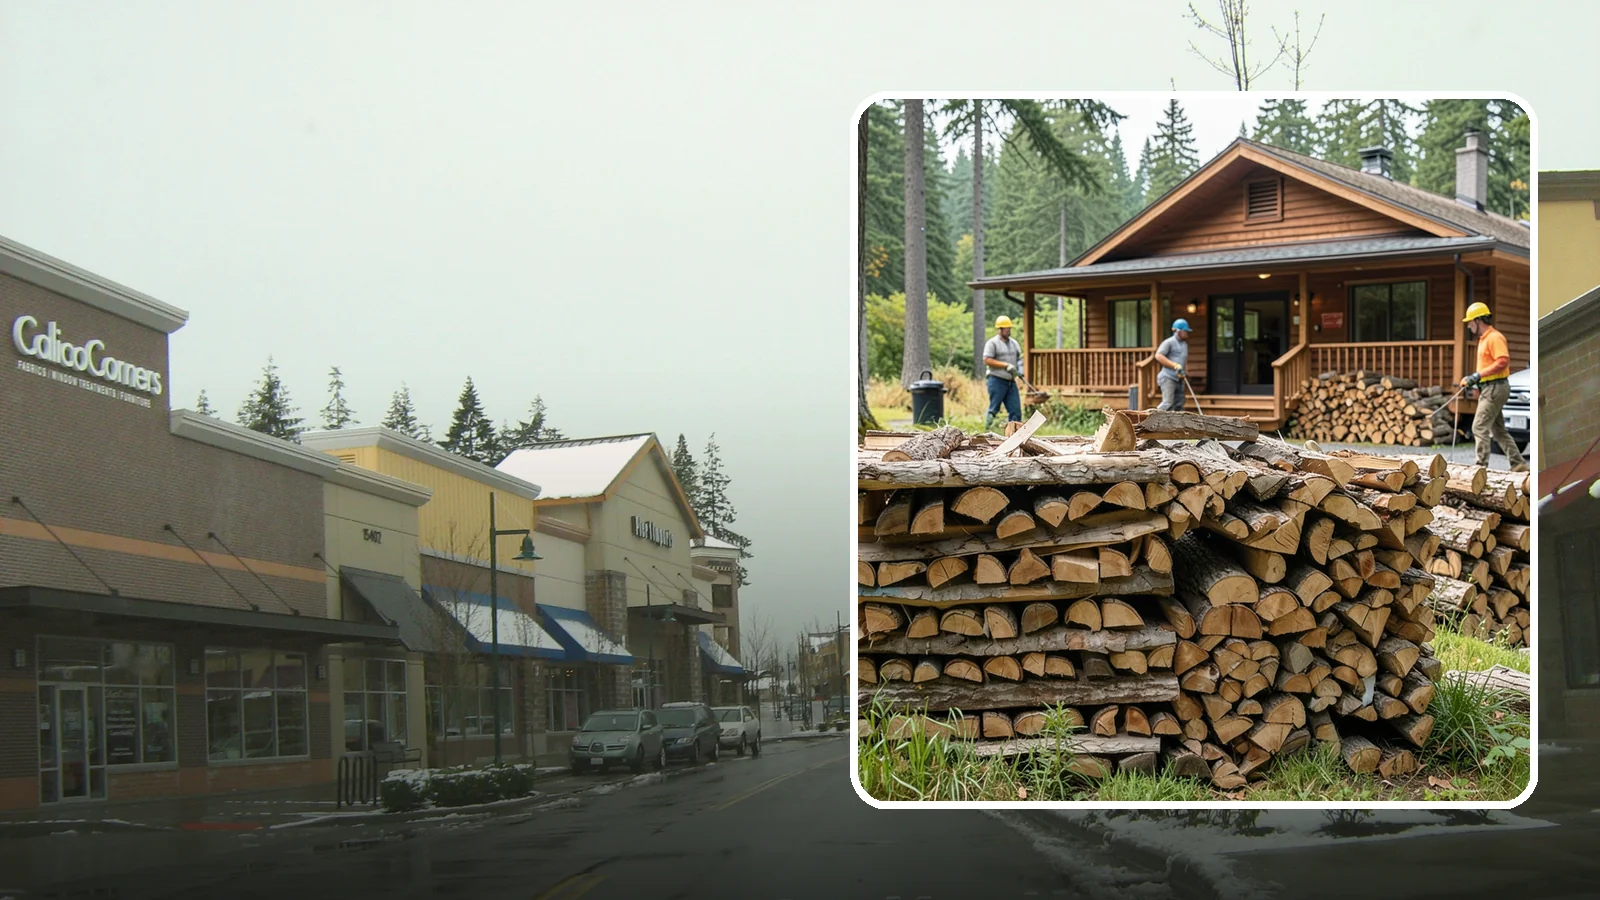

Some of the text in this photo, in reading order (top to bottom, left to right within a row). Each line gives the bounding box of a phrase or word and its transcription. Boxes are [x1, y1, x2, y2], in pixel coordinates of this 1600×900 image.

[17, 360, 47, 377] FABRICS
[51, 370, 78, 386] WINDOW
[78, 378, 117, 398] TREATMENTS
